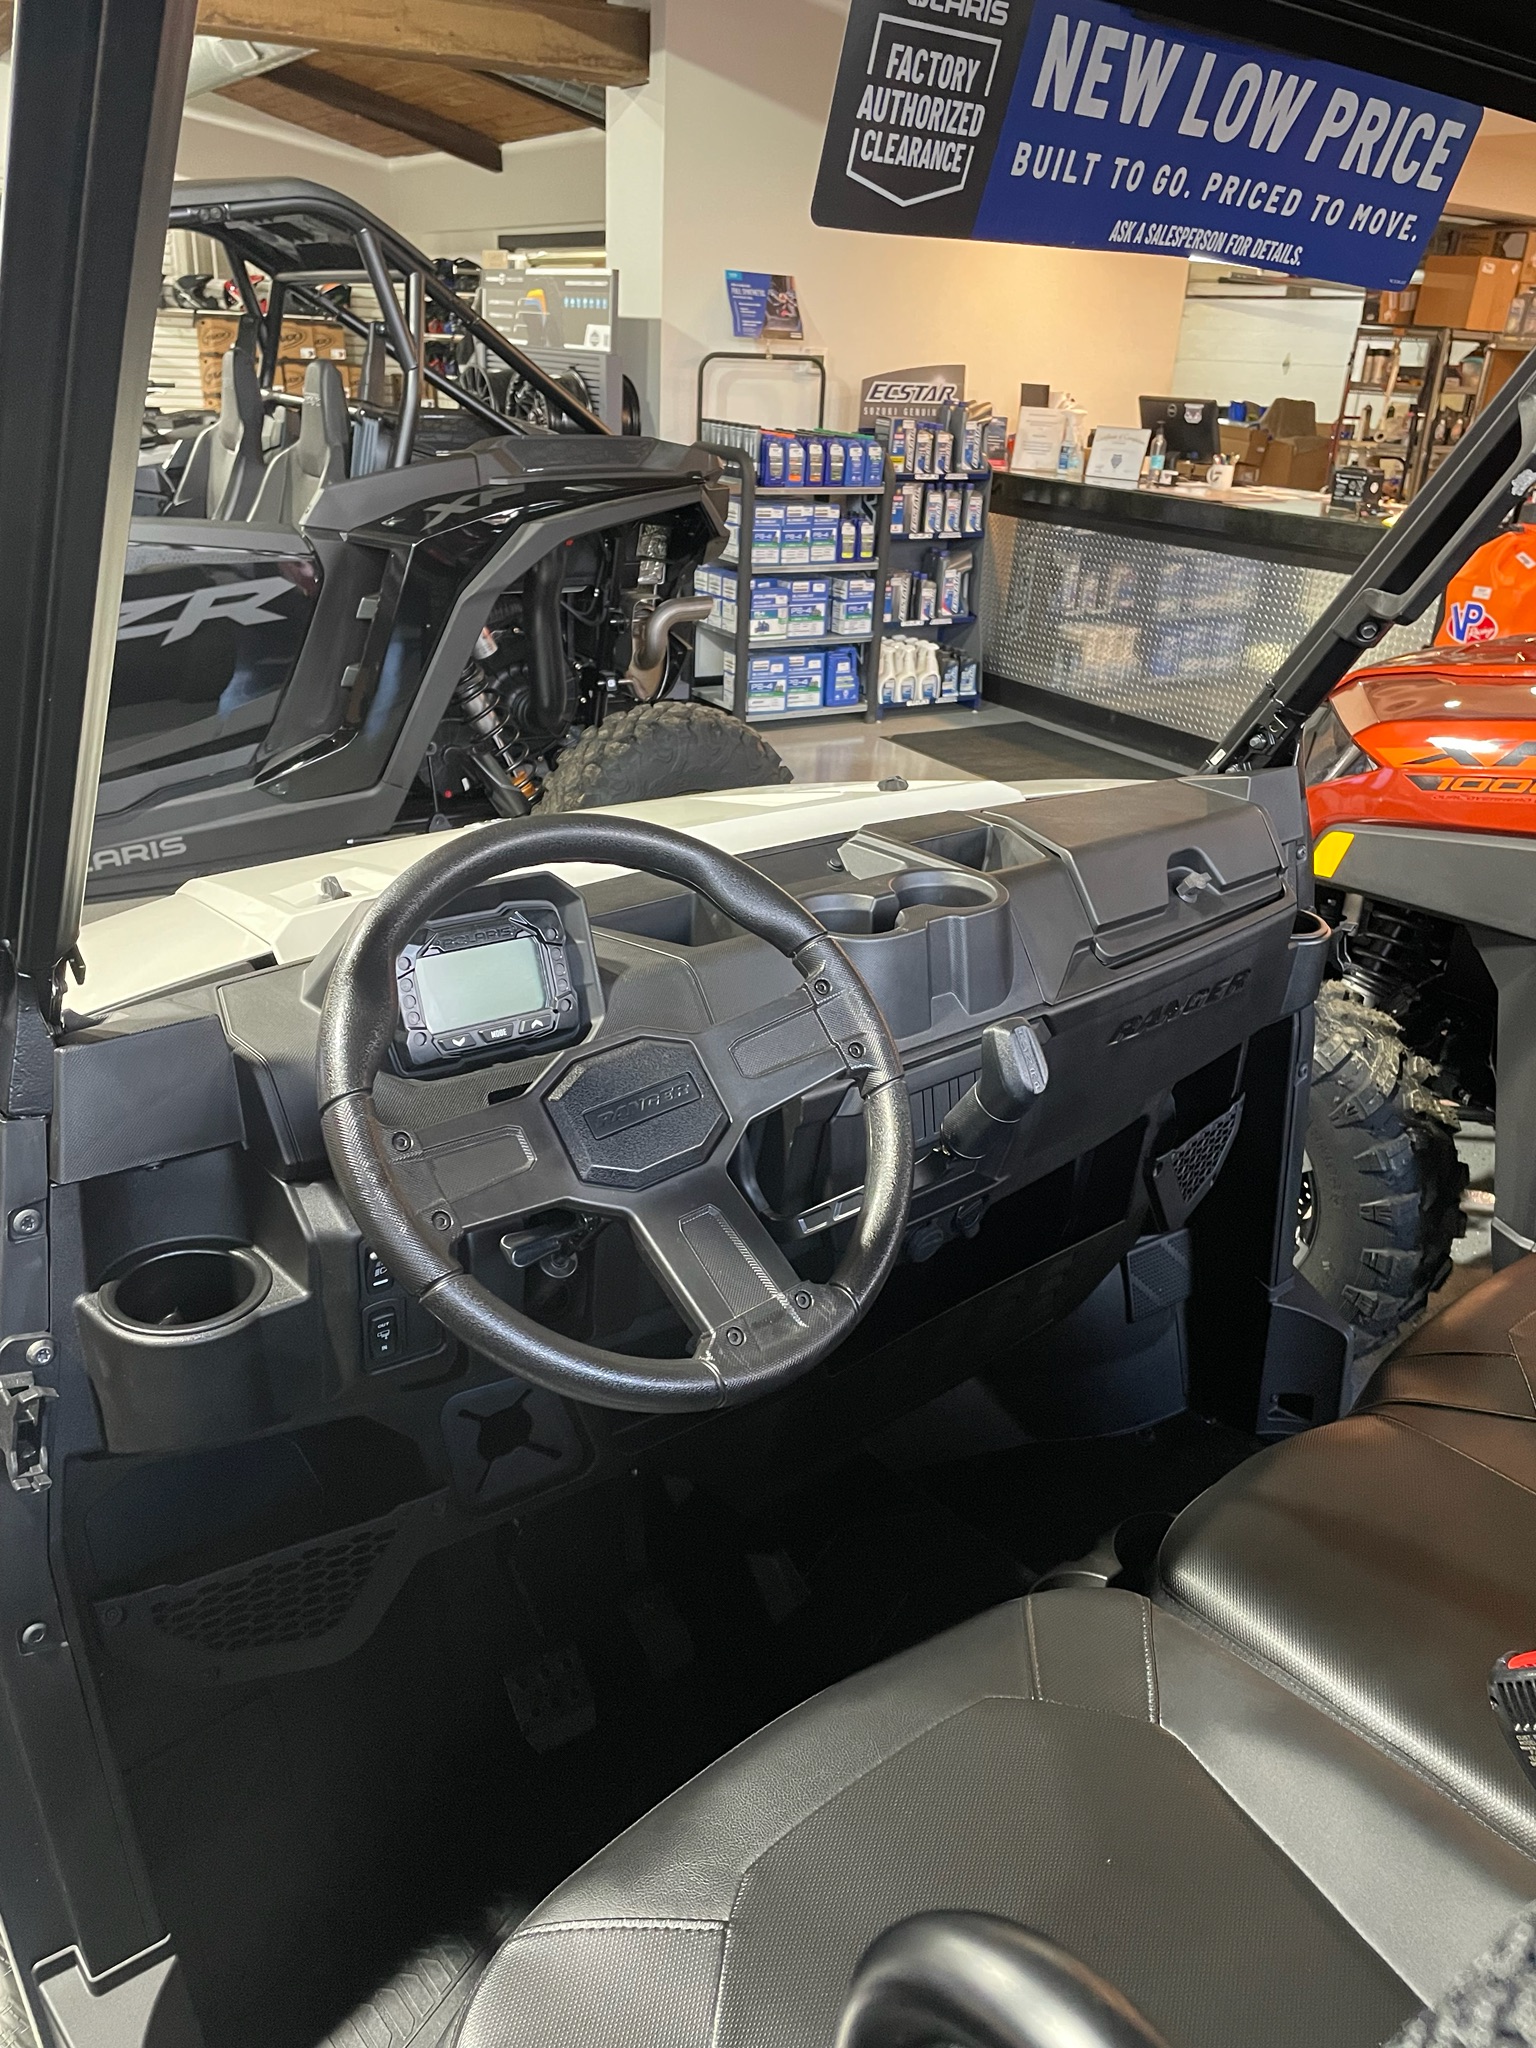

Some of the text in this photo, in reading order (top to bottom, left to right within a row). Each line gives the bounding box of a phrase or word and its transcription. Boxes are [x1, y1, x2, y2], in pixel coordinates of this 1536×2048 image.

[885, 42, 981, 93] FACTORY
[856, 84, 985, 137] AUTHORIZED
[1031, 14, 1467, 192] NEW LOW PRICE
[860, 129, 967, 173] CLEARANCE
[1010, 141, 1418, 243] BUILT TO GO. PRICED TO MOVE.
[1108, 219, 1304, 267] ASK A SALESPERSON FOR DETAILS.
[863, 406, 937, 417] SUZUKI GENUIN
[866, 382, 957, 403] ECSTAR
[420, 484, 526, 532] XP
[116, 575, 298, 648] ZR
[1452, 603, 1484, 642] VP
[1437, 776, 1536, 794] 100
[87, 836, 187, 873] ARIS
[442, 925, 512, 949] POLARIS
[1107, 968, 1252, 1047] RANGER
[490, 1028, 508, 1039] MODE
[596, 1082, 691, 1126] RANGER
[377, 1321, 390, 1329] OUT
